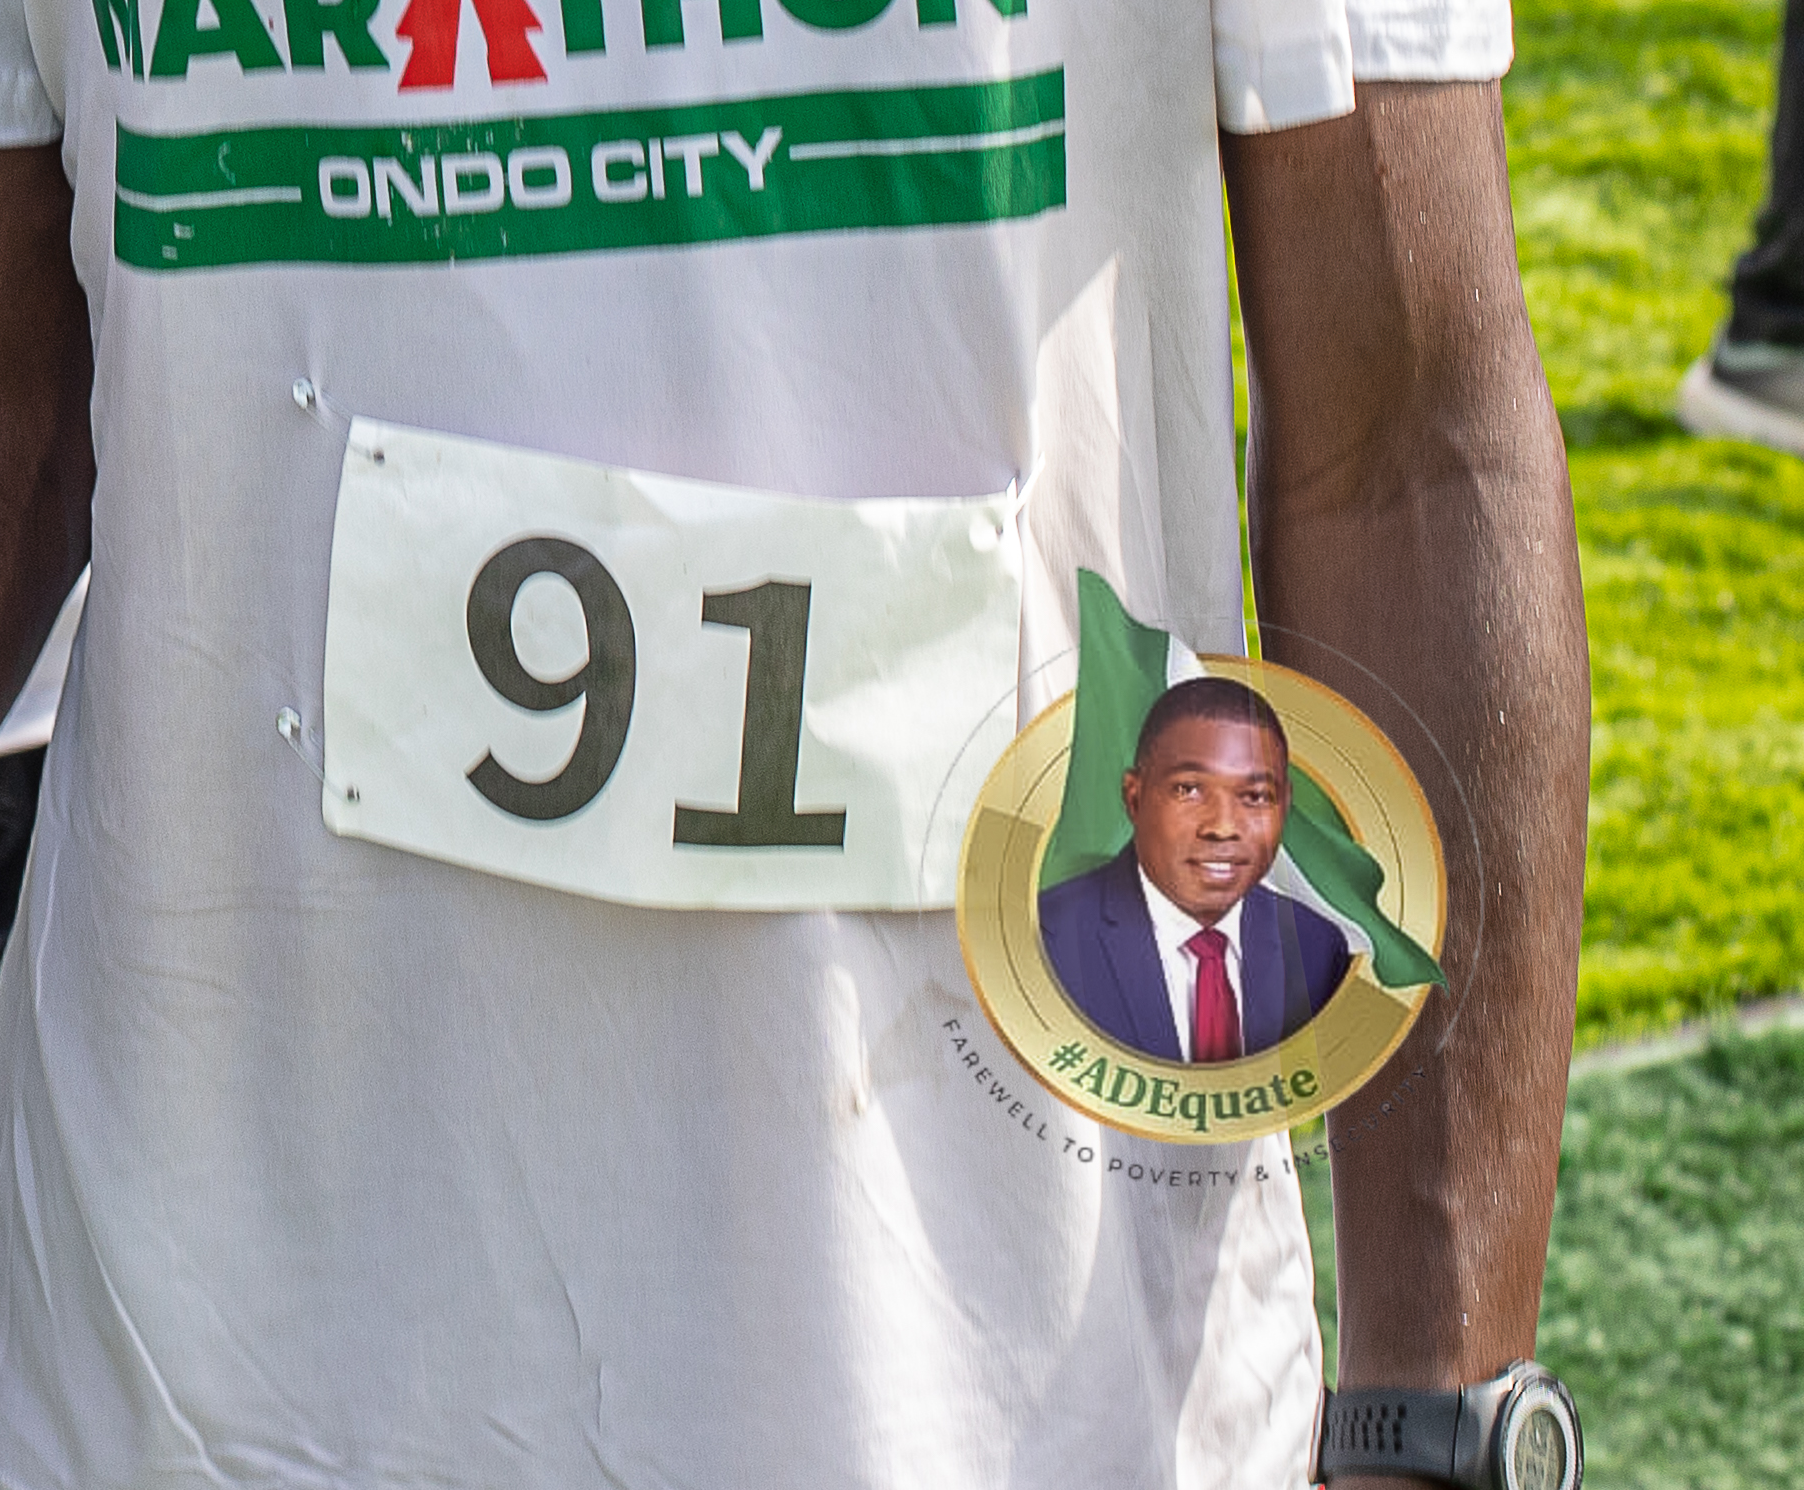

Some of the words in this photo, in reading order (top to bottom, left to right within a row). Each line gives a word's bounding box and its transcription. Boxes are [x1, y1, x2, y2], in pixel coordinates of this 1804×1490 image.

[319, 145, 573, 220] ONDO
[590, 125, 784, 204] CITY
[465, 535, 847, 851] 91
